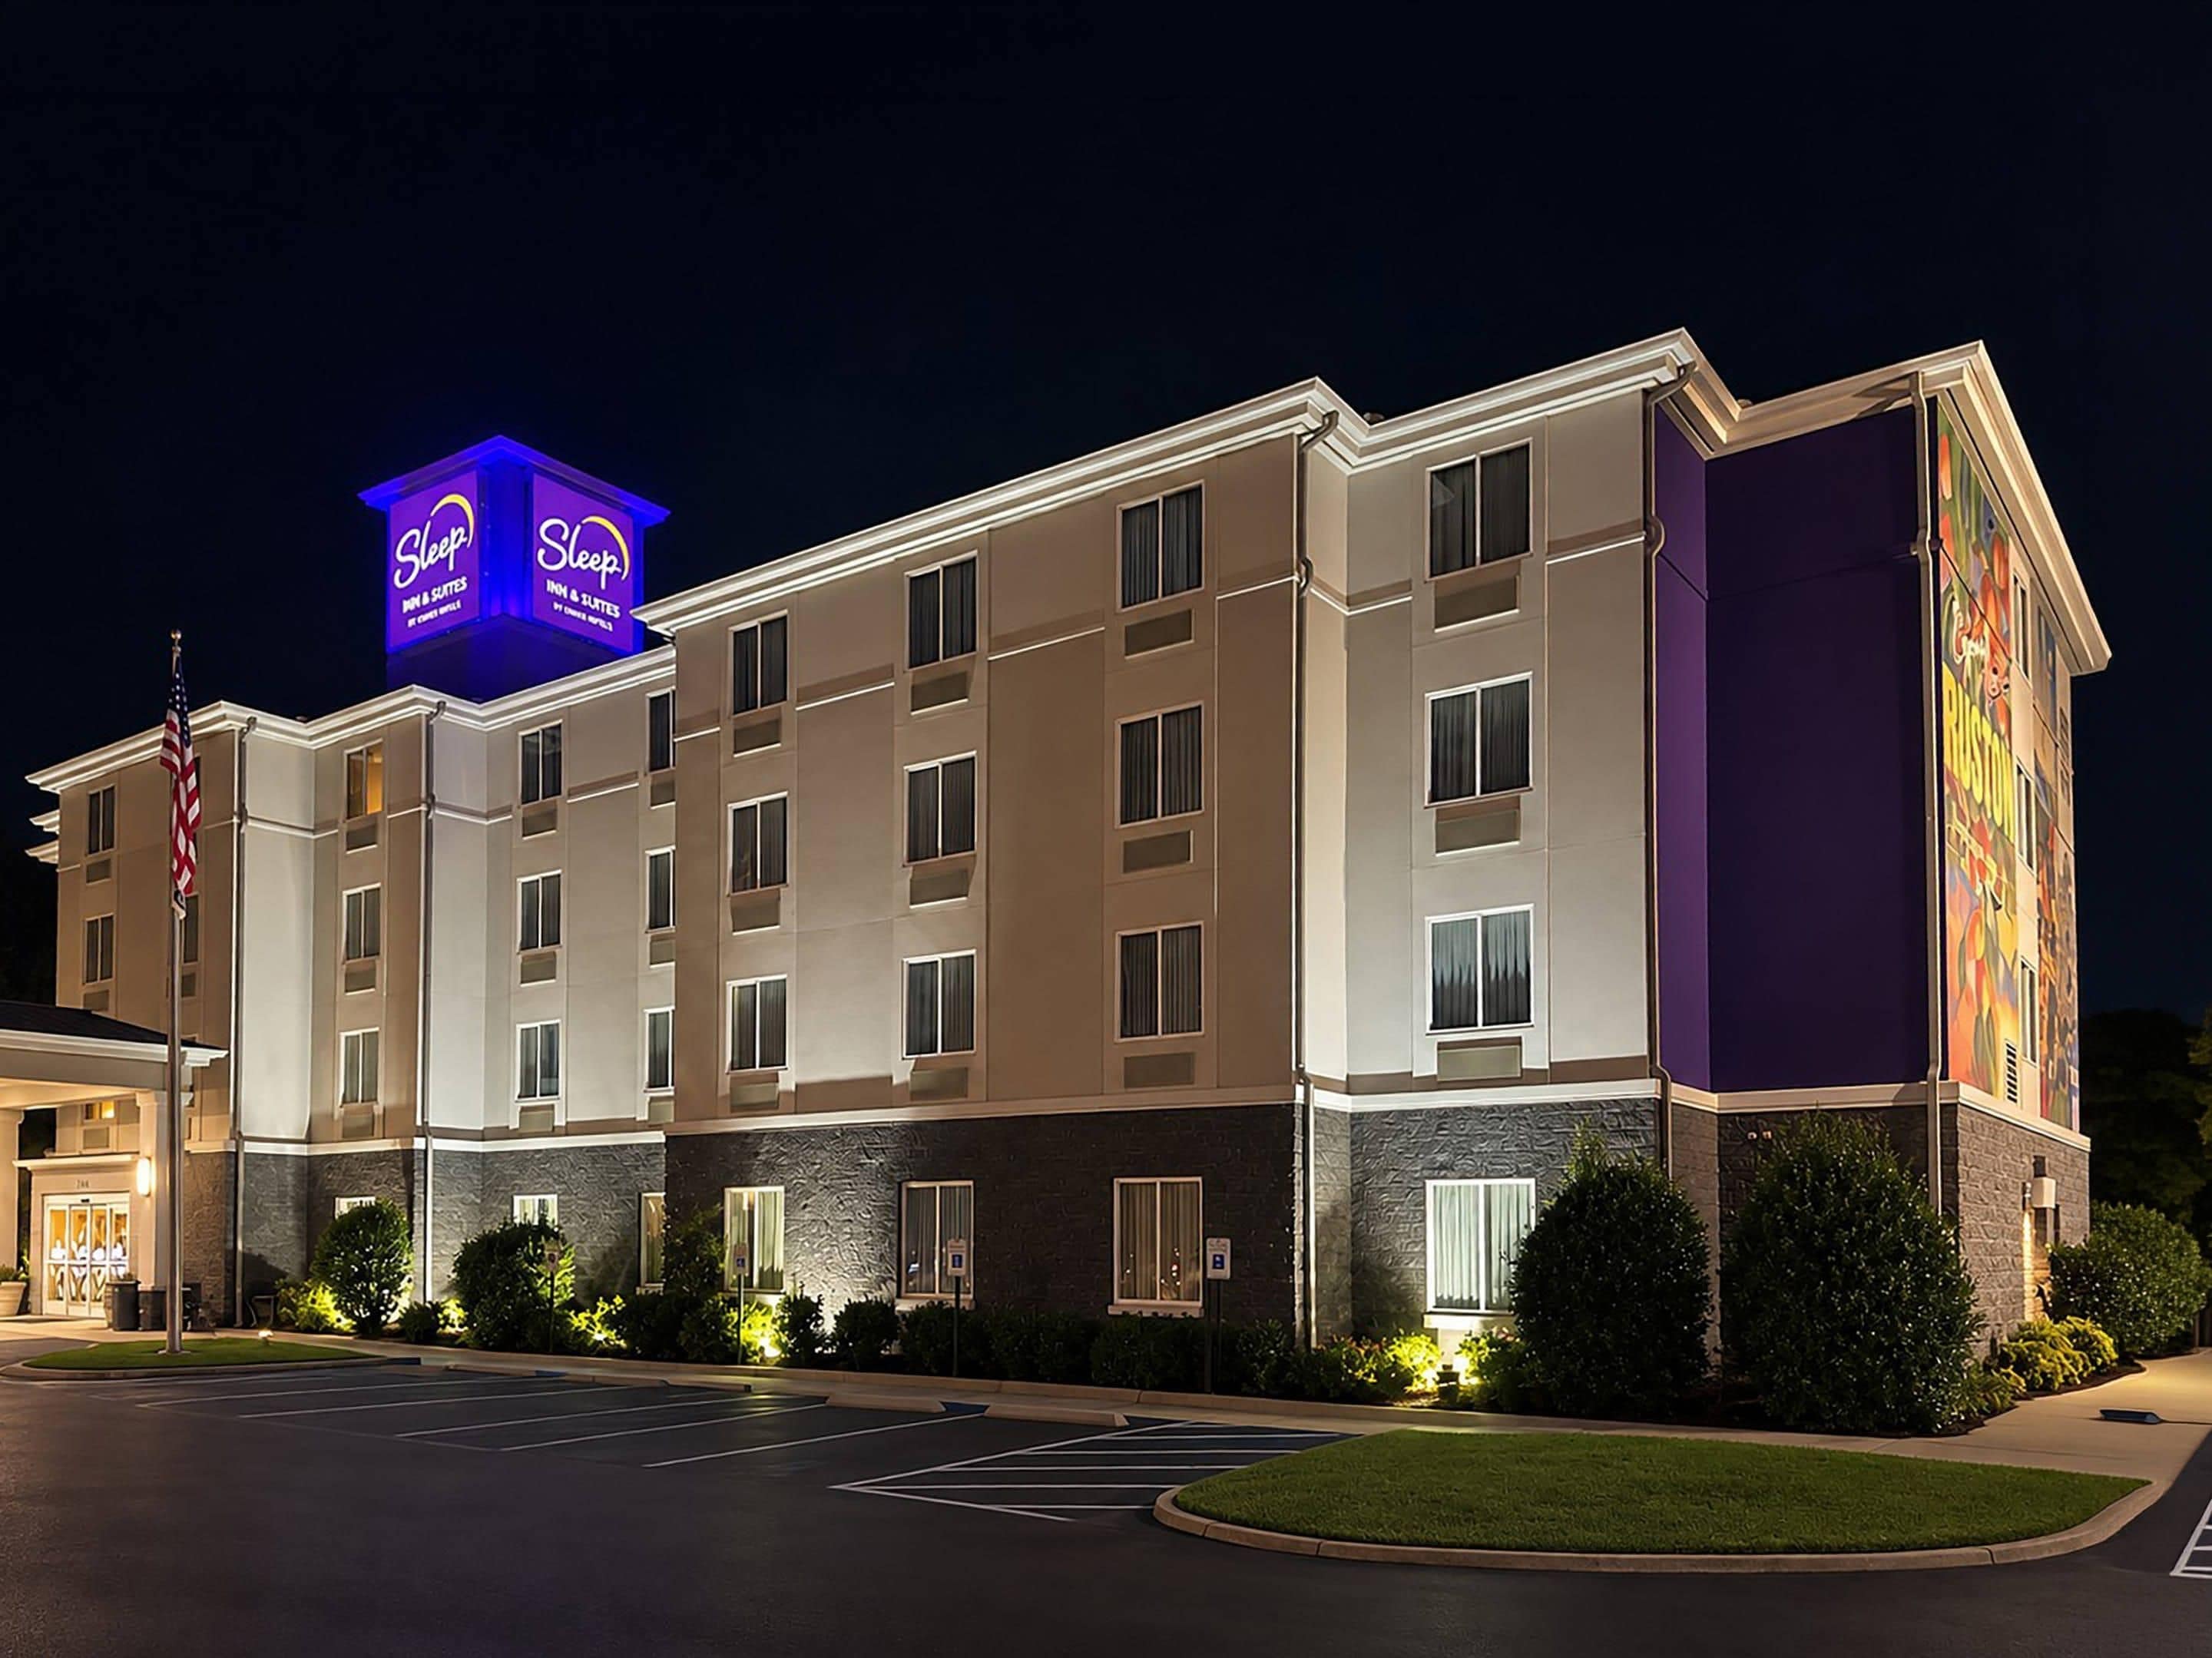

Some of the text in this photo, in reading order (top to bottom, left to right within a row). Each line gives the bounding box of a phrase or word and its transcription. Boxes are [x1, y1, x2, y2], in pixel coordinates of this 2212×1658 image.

[393, 520, 468, 589] Sleep
[431, 575, 468, 602] SUITES
[537, 518, 622, 591] Sleep
[547, 578, 568, 599] INN
[570, 588, 579, 602] &
[581, 592, 621, 618] SUITES
[1942, 660, 2015, 843] RUSTON
